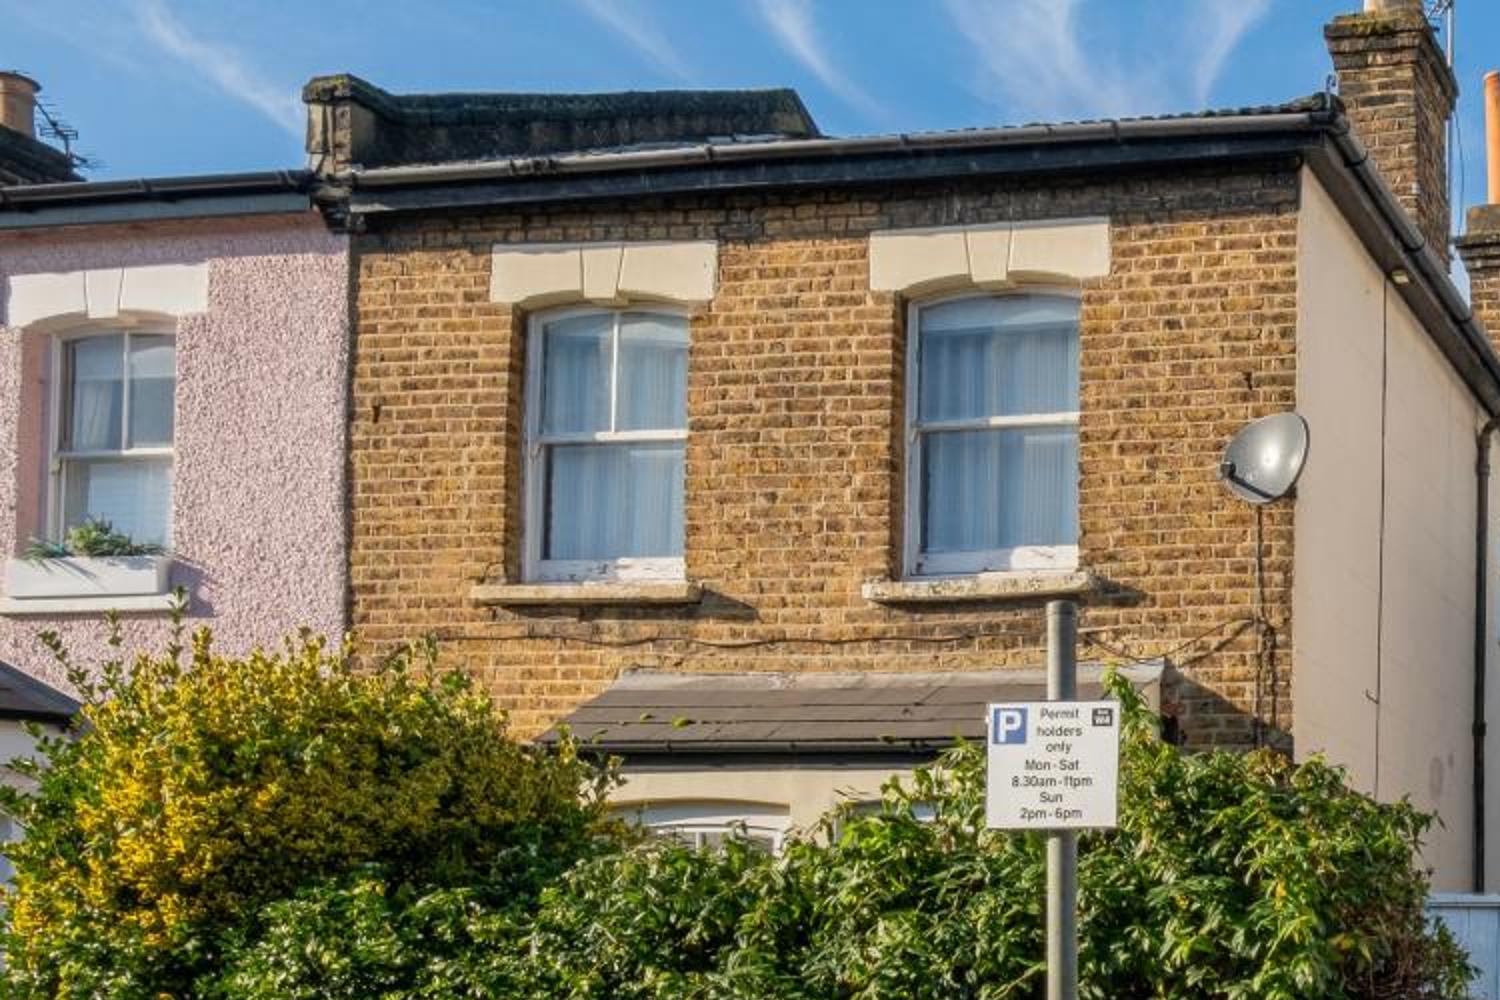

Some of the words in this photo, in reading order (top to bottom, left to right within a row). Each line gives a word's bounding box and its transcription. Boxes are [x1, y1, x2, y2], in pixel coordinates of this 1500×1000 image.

[1040, 707, 1079, 720] Permit
[998, 710, 1022, 743] P
[1036, 725, 1083, 737] holders
[1045, 740, 1073, 755] only
[1039, 791, 1063, 803] Sun
